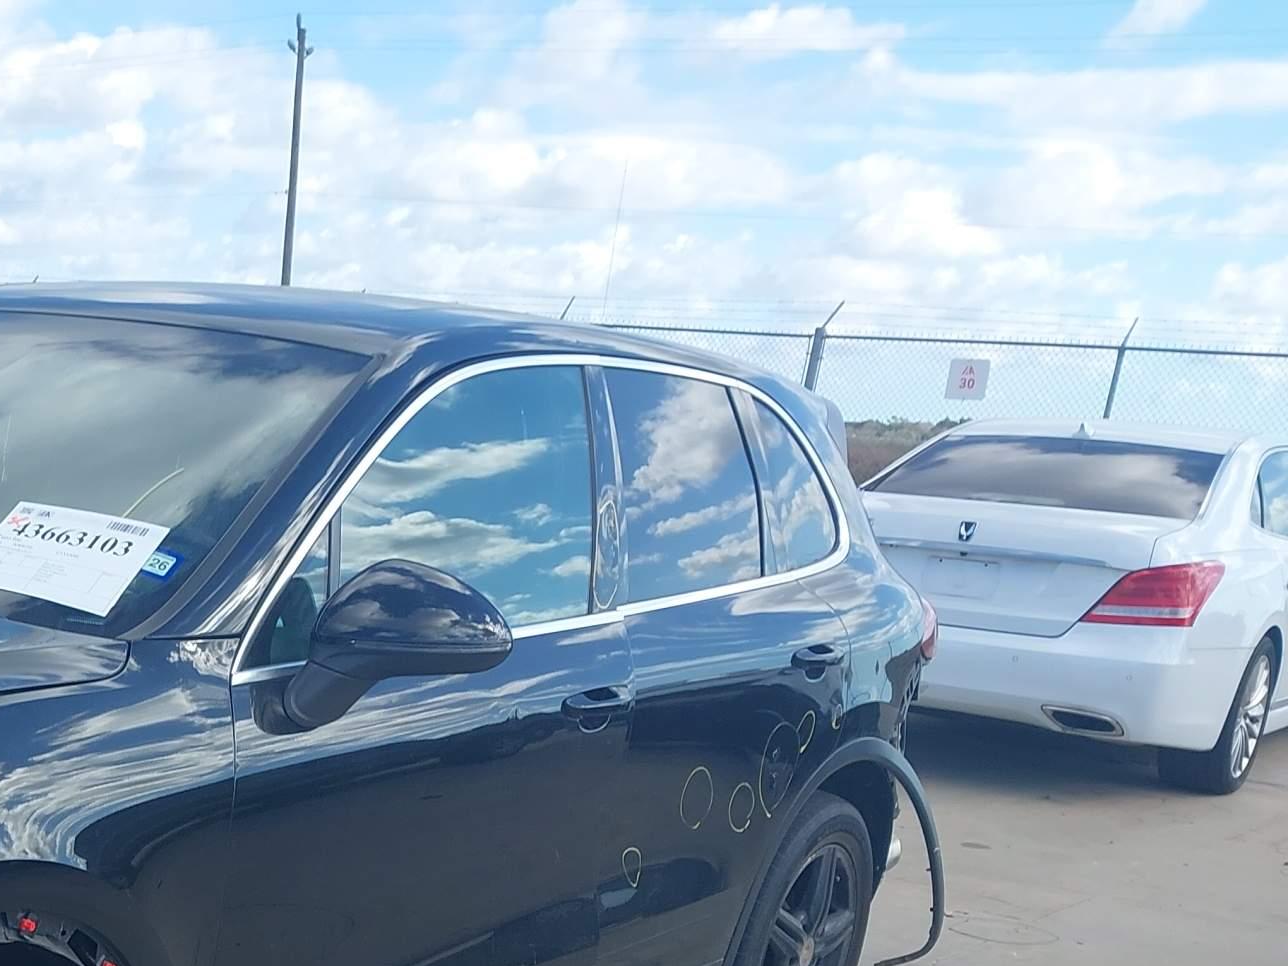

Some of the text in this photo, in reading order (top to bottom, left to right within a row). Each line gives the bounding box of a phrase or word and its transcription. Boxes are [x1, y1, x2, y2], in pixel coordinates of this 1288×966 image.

[959, 377, 975, 389] 30
[13, 521, 134, 557] 43663103
[148, 557, 170, 571] 26
